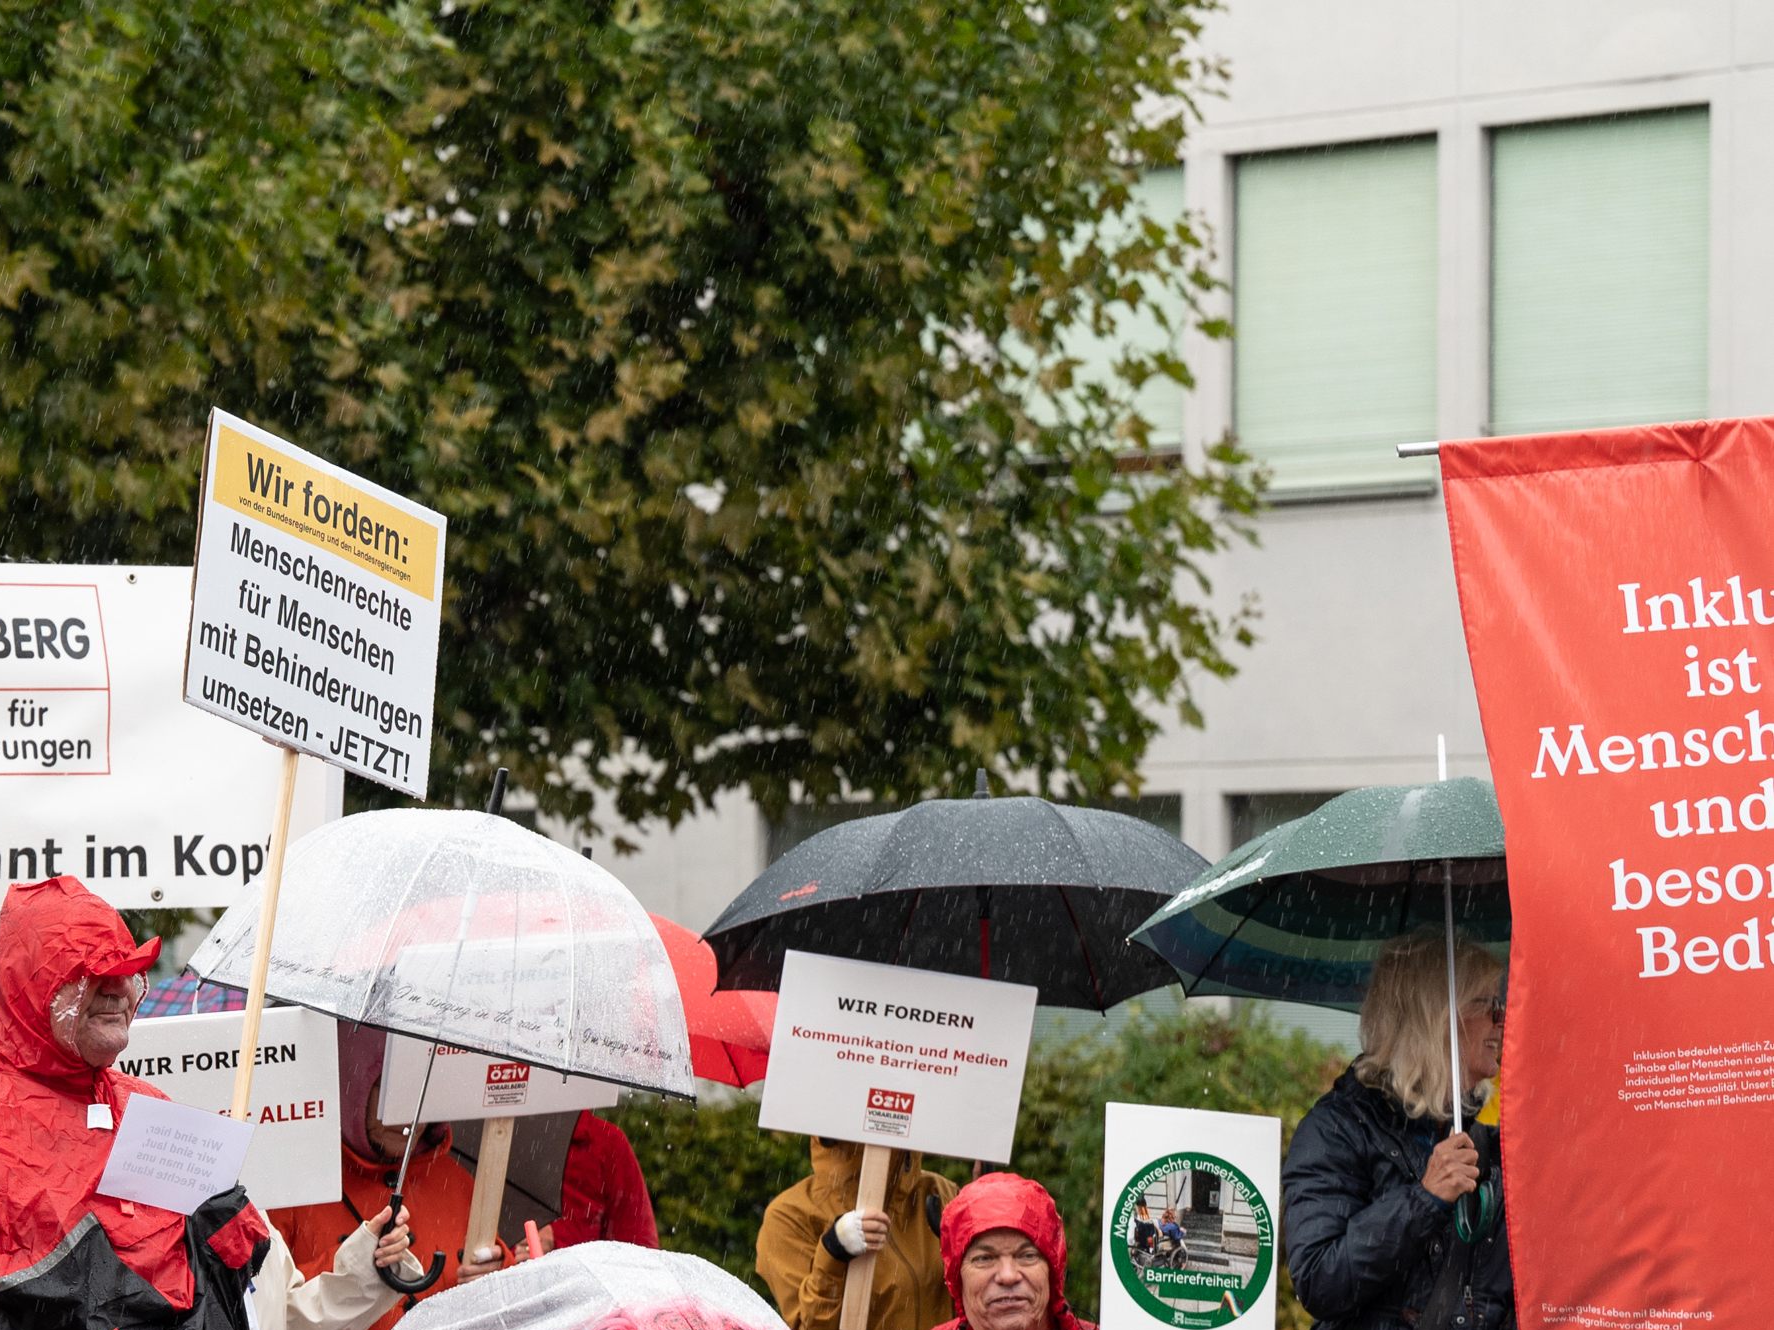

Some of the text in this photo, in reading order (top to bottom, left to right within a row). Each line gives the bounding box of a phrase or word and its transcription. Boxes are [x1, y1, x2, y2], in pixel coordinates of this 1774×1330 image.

[247, 452, 409, 564] Wir fordern:
[239, 496, 411, 582] von der Bundesregierung und den Landesregierungen
[230, 522, 412, 632] Menschenrechte
[239, 579, 395, 676] für Menschen
[199, 620, 423, 739] mit Behinderungen
[1684, 645, 1761, 698] ist
[8, 699, 49, 728] für
[202, 675, 308, 742] umsetzen
[330, 726, 411, 783] JETZT!
[1651, 777, 1774, 839] und
[86, 834, 147, 878] im
[1608, 858, 1774, 913] beso
[837, 997, 975, 1030] WIR FORDERN
[119, 1056, 173, 1077] WIR
[791, 1026, 1009, 1068] Kommunikation und Medien
[836, 1050, 959, 1077] ohne Barrieren!
[1623, 1062, 1667, 1075] Teilhabe
[1668, 1060, 1691, 1072] aller
[1692, 1056, 1743, 1070] Menschen
[1744, 1055, 1753, 1065] in
[1633, 1049, 1676, 1061] Inklusion
[1678, 1046, 1722, 1058] bedeutet
[1724, 1042, 1762, 1054] wörtlich
[1617, 1089, 1661, 1102] Sprache
[1662, 1086, 1686, 1097] oder
[1740, 1079, 1769, 1091] Unser
[1625, 1073, 1688, 1087] individuellen
[1689, 1069, 1744, 1083] Merkmalen
[1745, 1067, 1762, 1078] wie
[259, 1100, 325, 1125] ALLE!
[1634, 1100, 1652, 1111] von
[1654, 1098, 1705, 1110] Menschen
[1707, 1096, 1721, 1106] mit
[1113, 1157, 1273, 1247] Menschenrechte umsetzen! JETZT!
[1146, 1268, 1240, 1290] Barrierefreiheit
